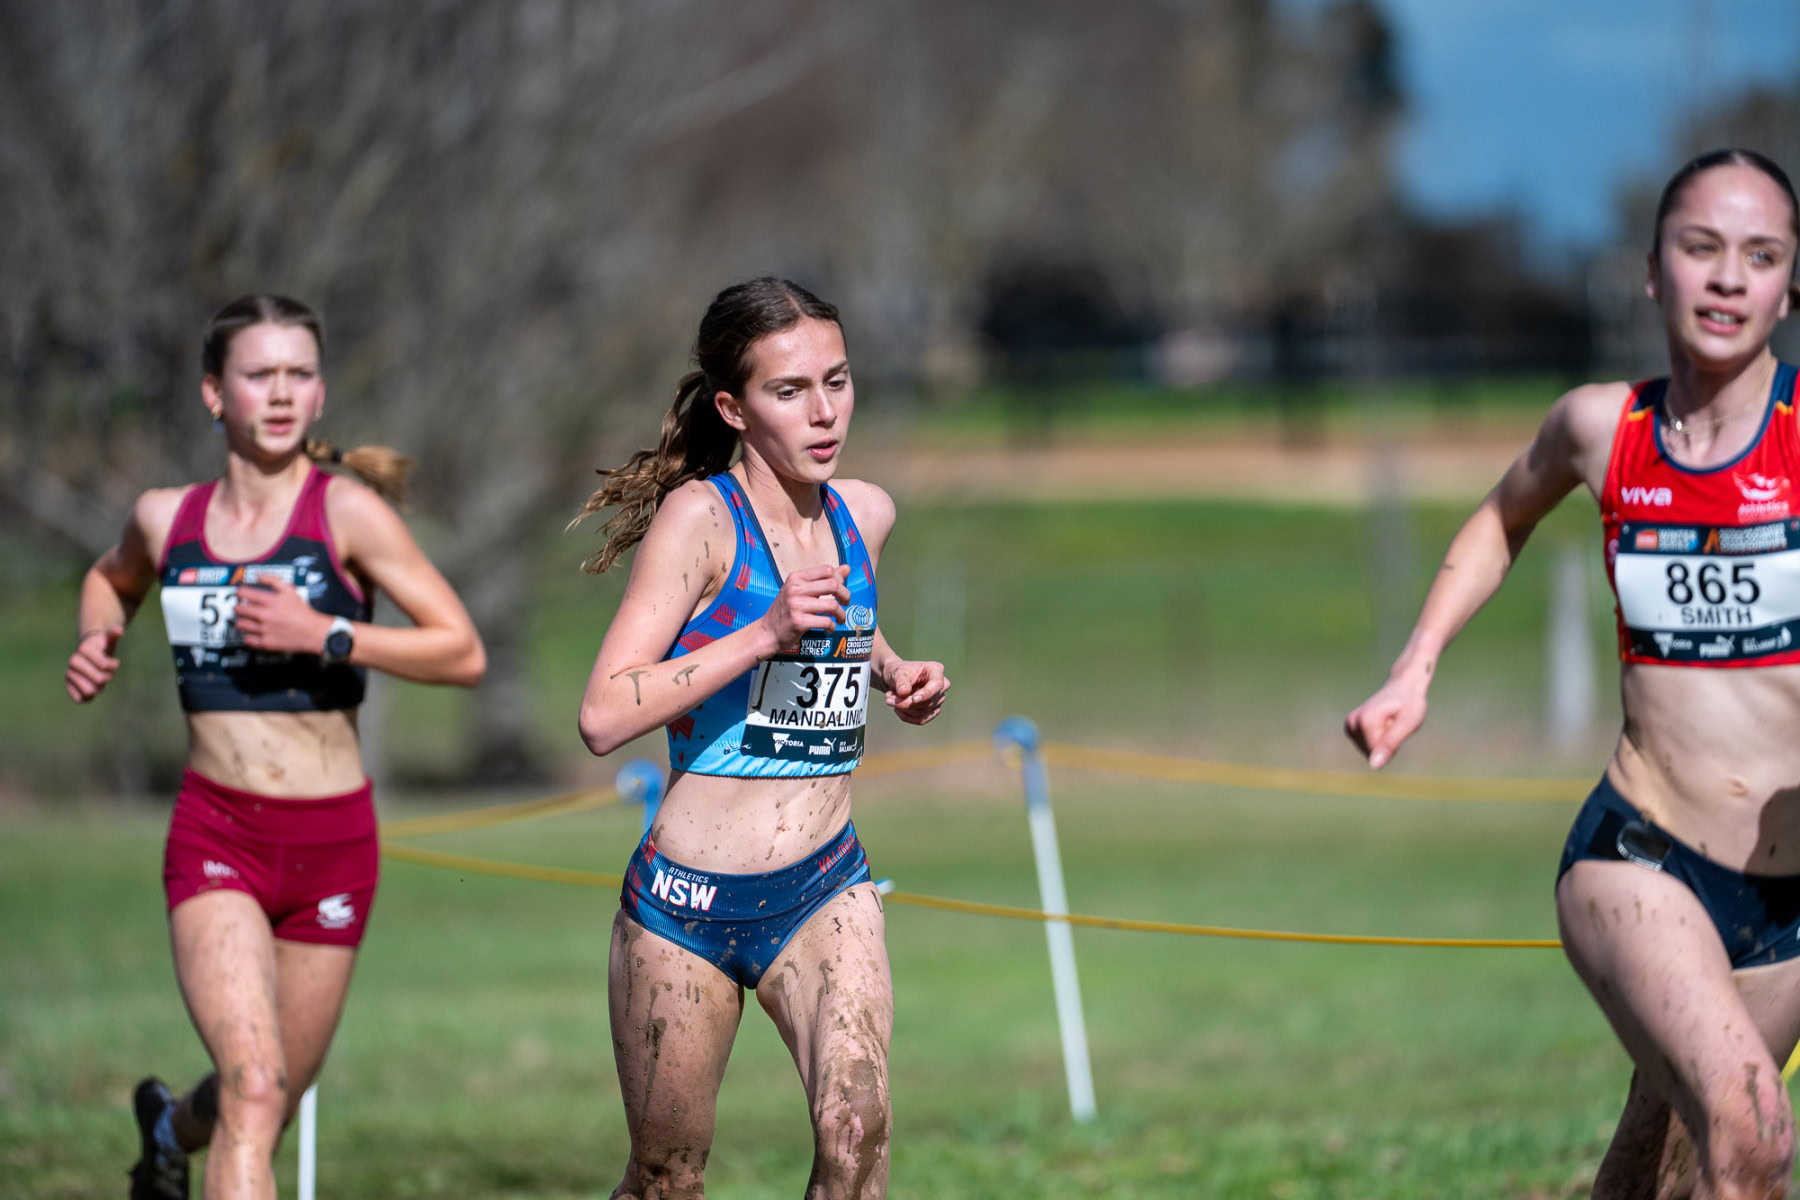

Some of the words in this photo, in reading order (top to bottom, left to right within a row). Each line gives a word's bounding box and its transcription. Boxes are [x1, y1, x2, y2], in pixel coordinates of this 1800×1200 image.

[1621, 486, 1673, 507] viva
[1666, 562, 1760, 605] 865
[1681, 606, 1752, 625] SMITH
[800, 647, 825, 656] SERIES
[801, 639, 831, 648] WINTER
[796, 666, 862, 709] 375
[769, 708, 863, 727] MANDALINIC
[774, 739, 804, 748] VICTORIA
[809, 745, 831, 756] PUMA
[668, 866, 710, 884] ATHLETICS
[651, 868, 718, 911] NSW
